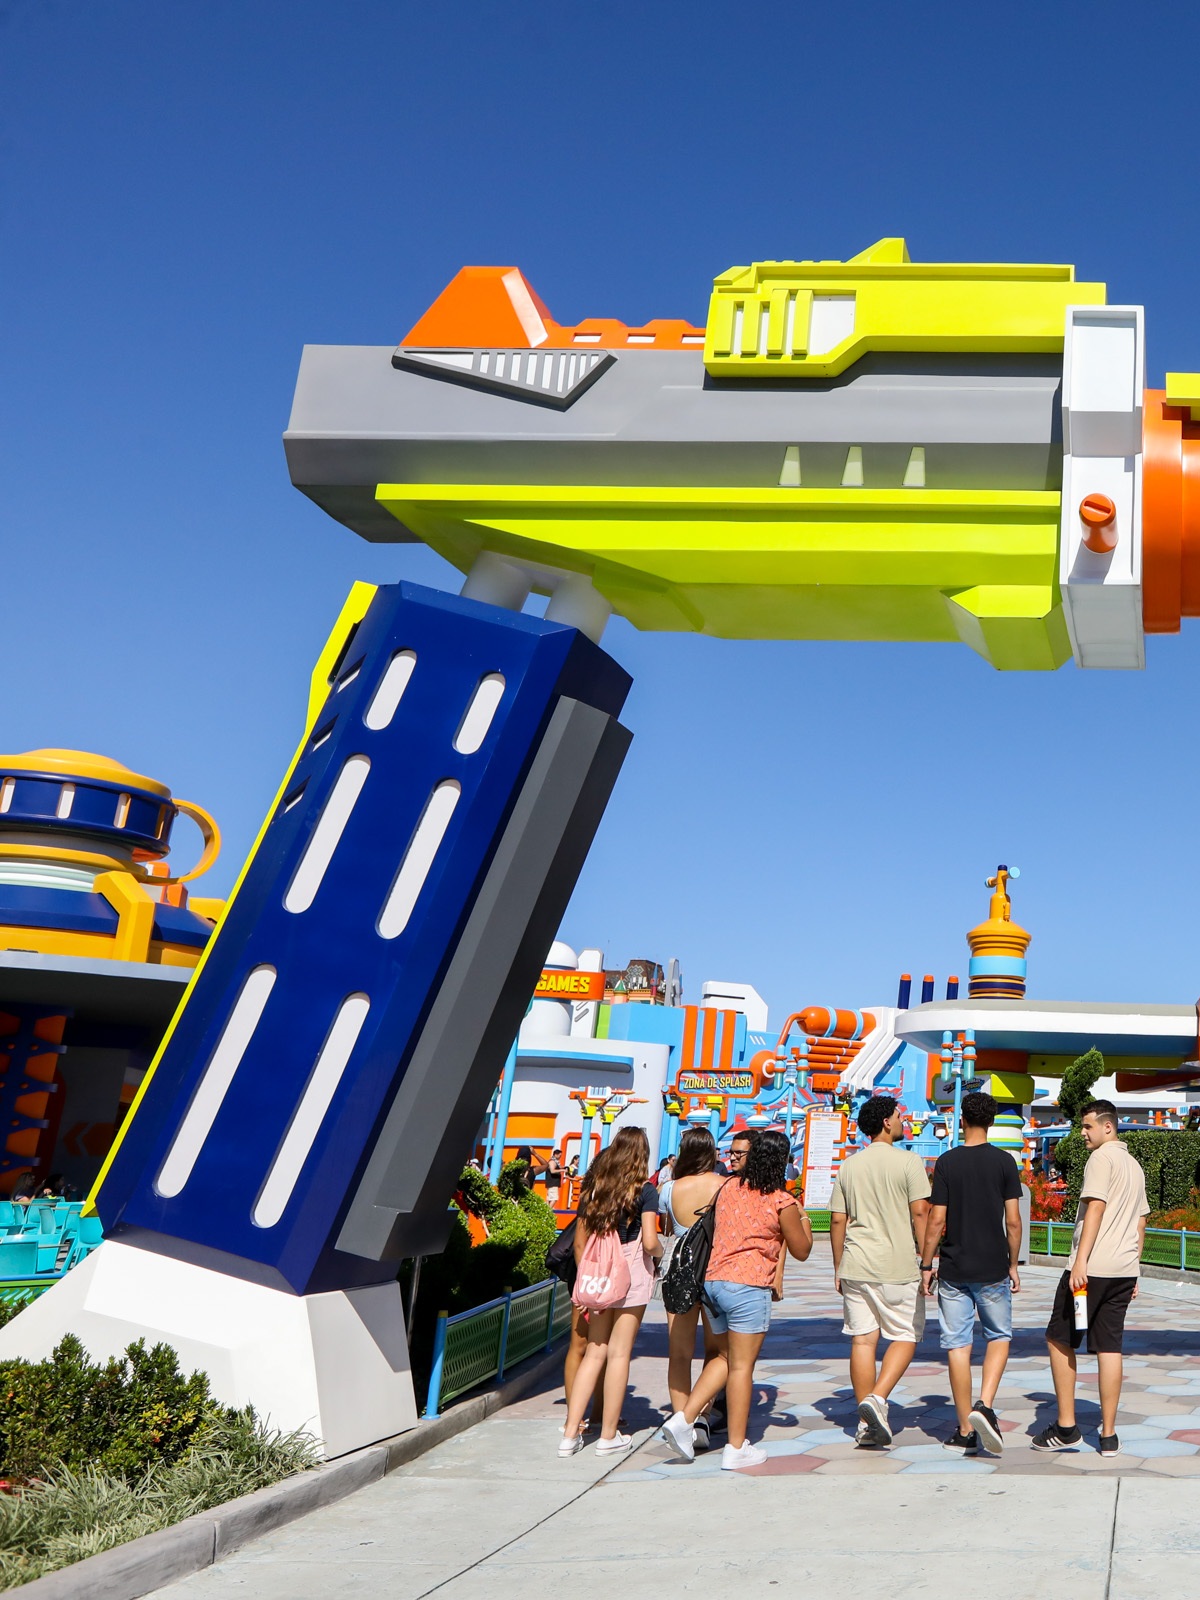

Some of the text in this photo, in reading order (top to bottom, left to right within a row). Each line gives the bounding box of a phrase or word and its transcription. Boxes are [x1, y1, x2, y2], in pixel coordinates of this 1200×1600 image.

[535, 974, 590, 993] GAMES
[684, 1075, 752, 1089] ZONA DE SPLASH
[580, 1274, 611, 1295] T60
